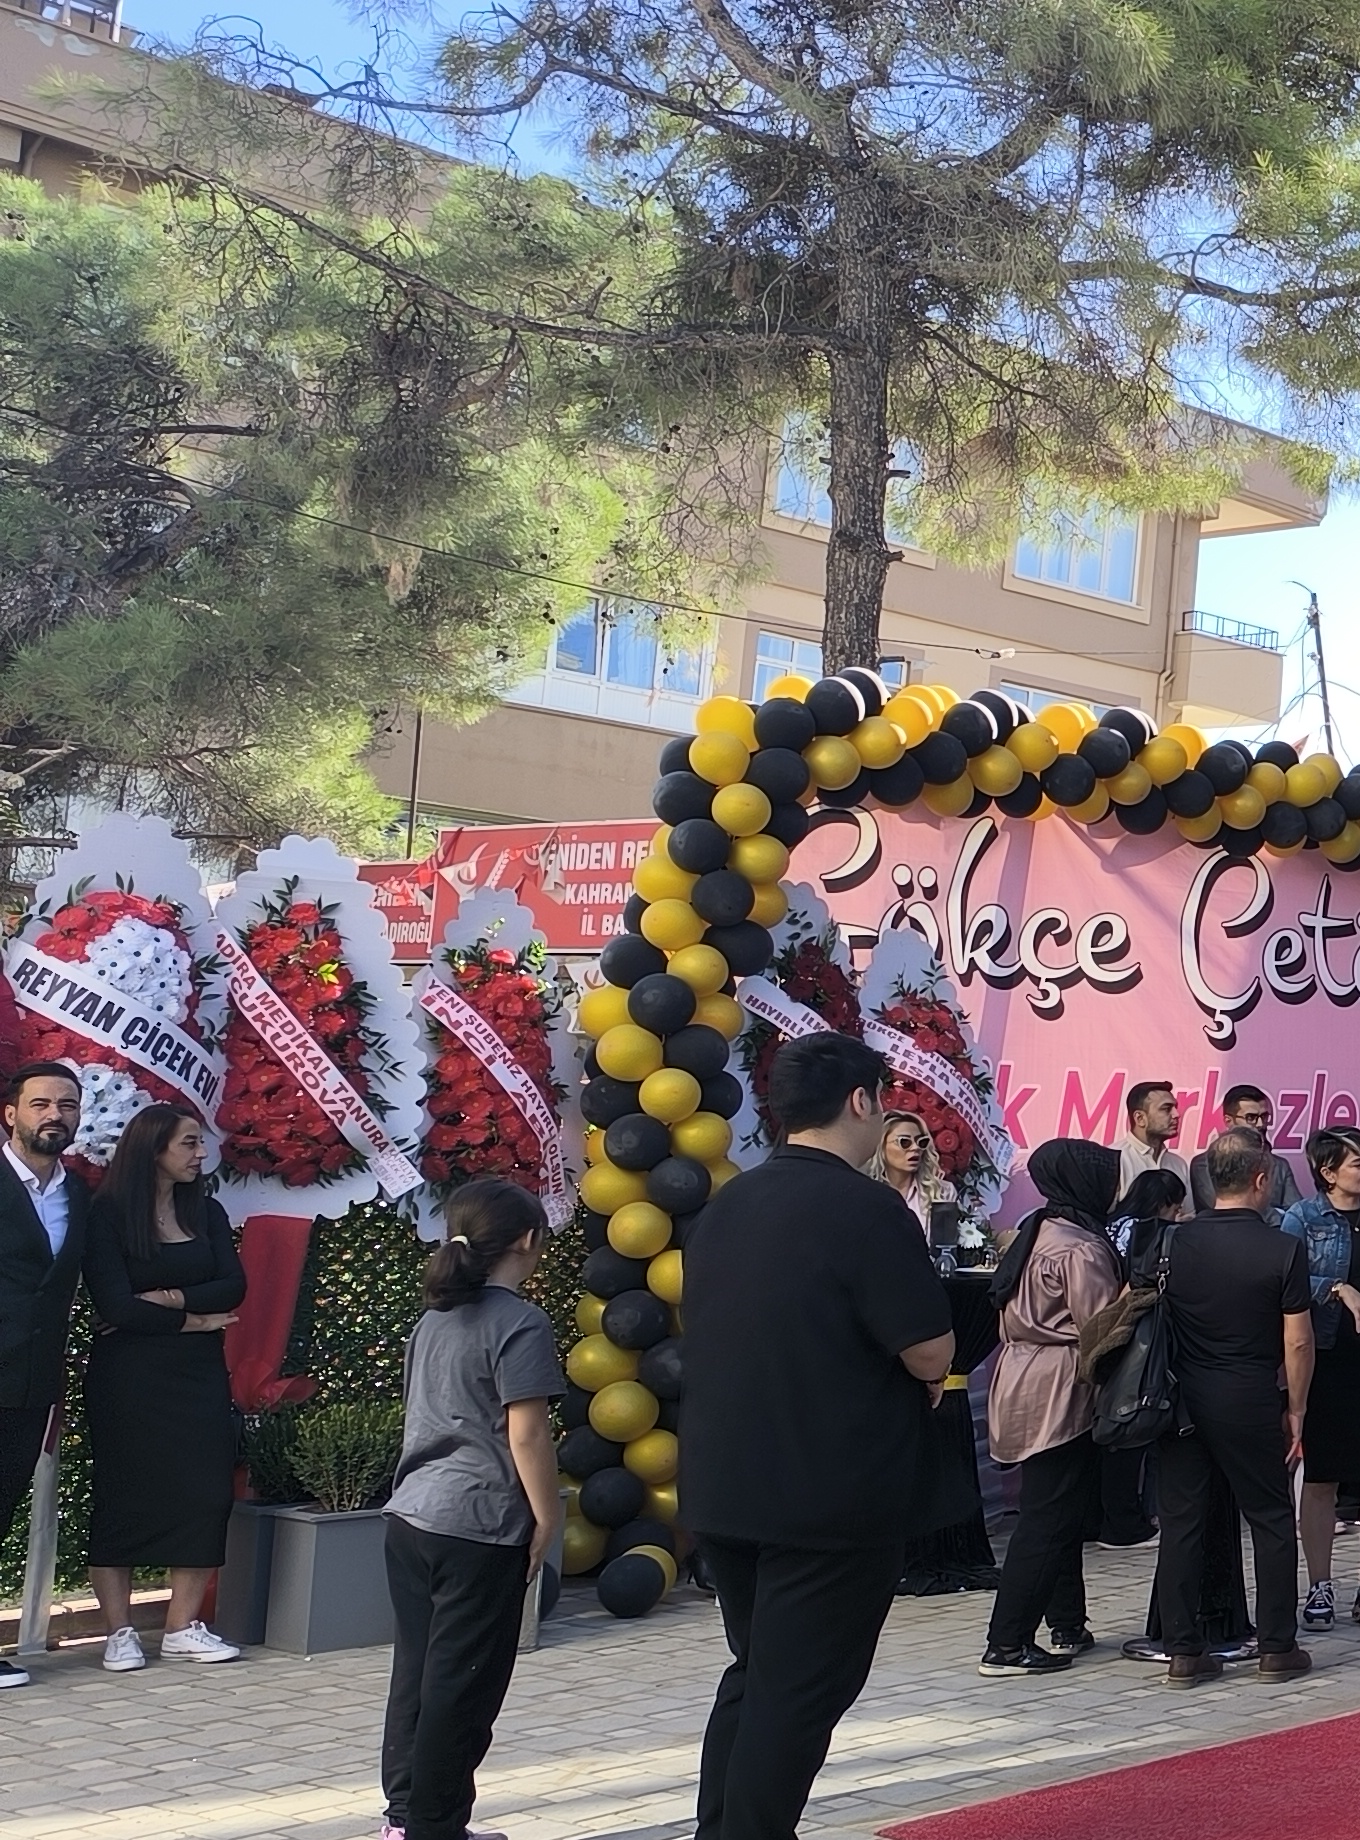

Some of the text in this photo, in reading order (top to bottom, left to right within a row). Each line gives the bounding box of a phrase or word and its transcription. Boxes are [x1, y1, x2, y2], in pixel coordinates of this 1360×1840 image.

[621, 840, 654, 869] RE
[581, 908, 597, 936] İL
[12, 957, 220, 1107] REYYAN ÇİÇEK EVİ
[254, 991, 331, 1082] MEDİKAL
[420, 994, 498, 1067] İNCİ
[744, 994, 805, 1036] HAYIRLI
[889, 1043, 951, 1086] LEYLA
[548, 1143, 563, 1195] OLSUN
